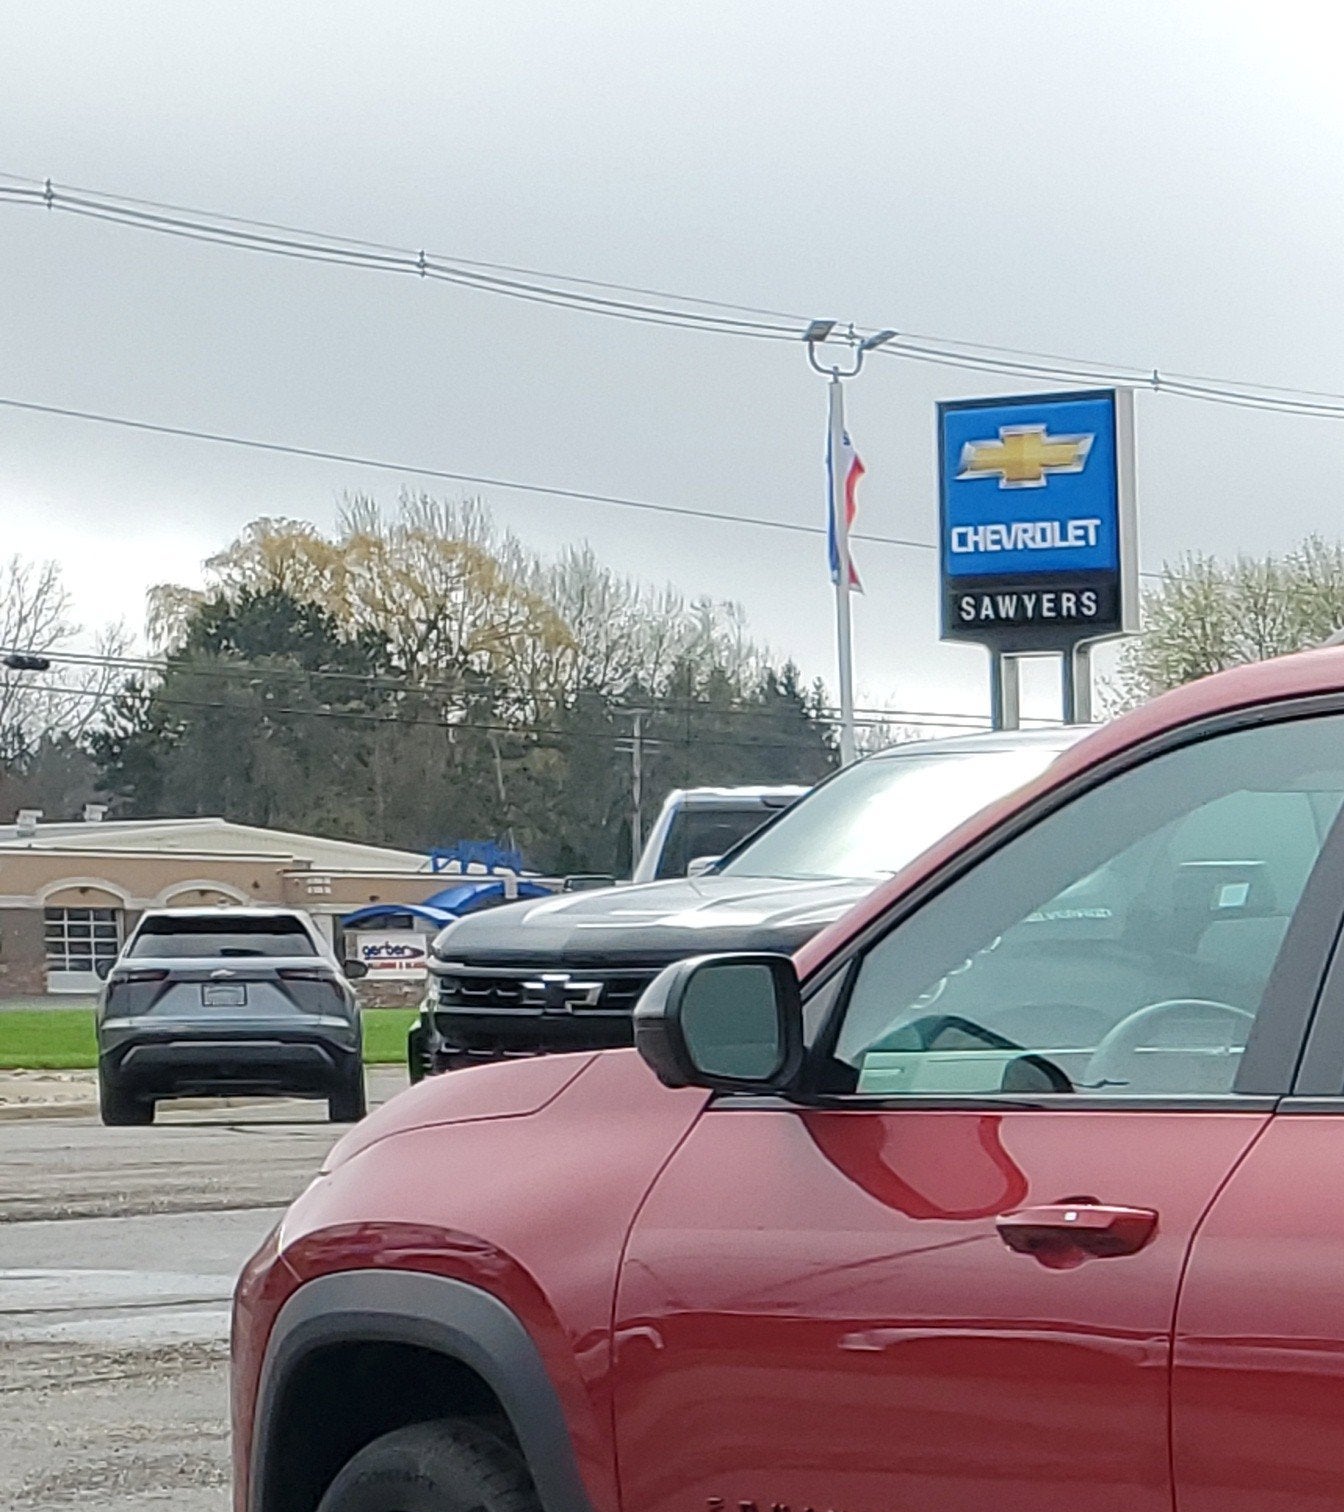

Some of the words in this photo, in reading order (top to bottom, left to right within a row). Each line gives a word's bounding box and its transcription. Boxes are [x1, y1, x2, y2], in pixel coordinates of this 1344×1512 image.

[951, 518, 1101, 553] CHEVROLET
[959, 591, 1097, 621] SAWYERS
[362, 941, 411, 960] gerber
